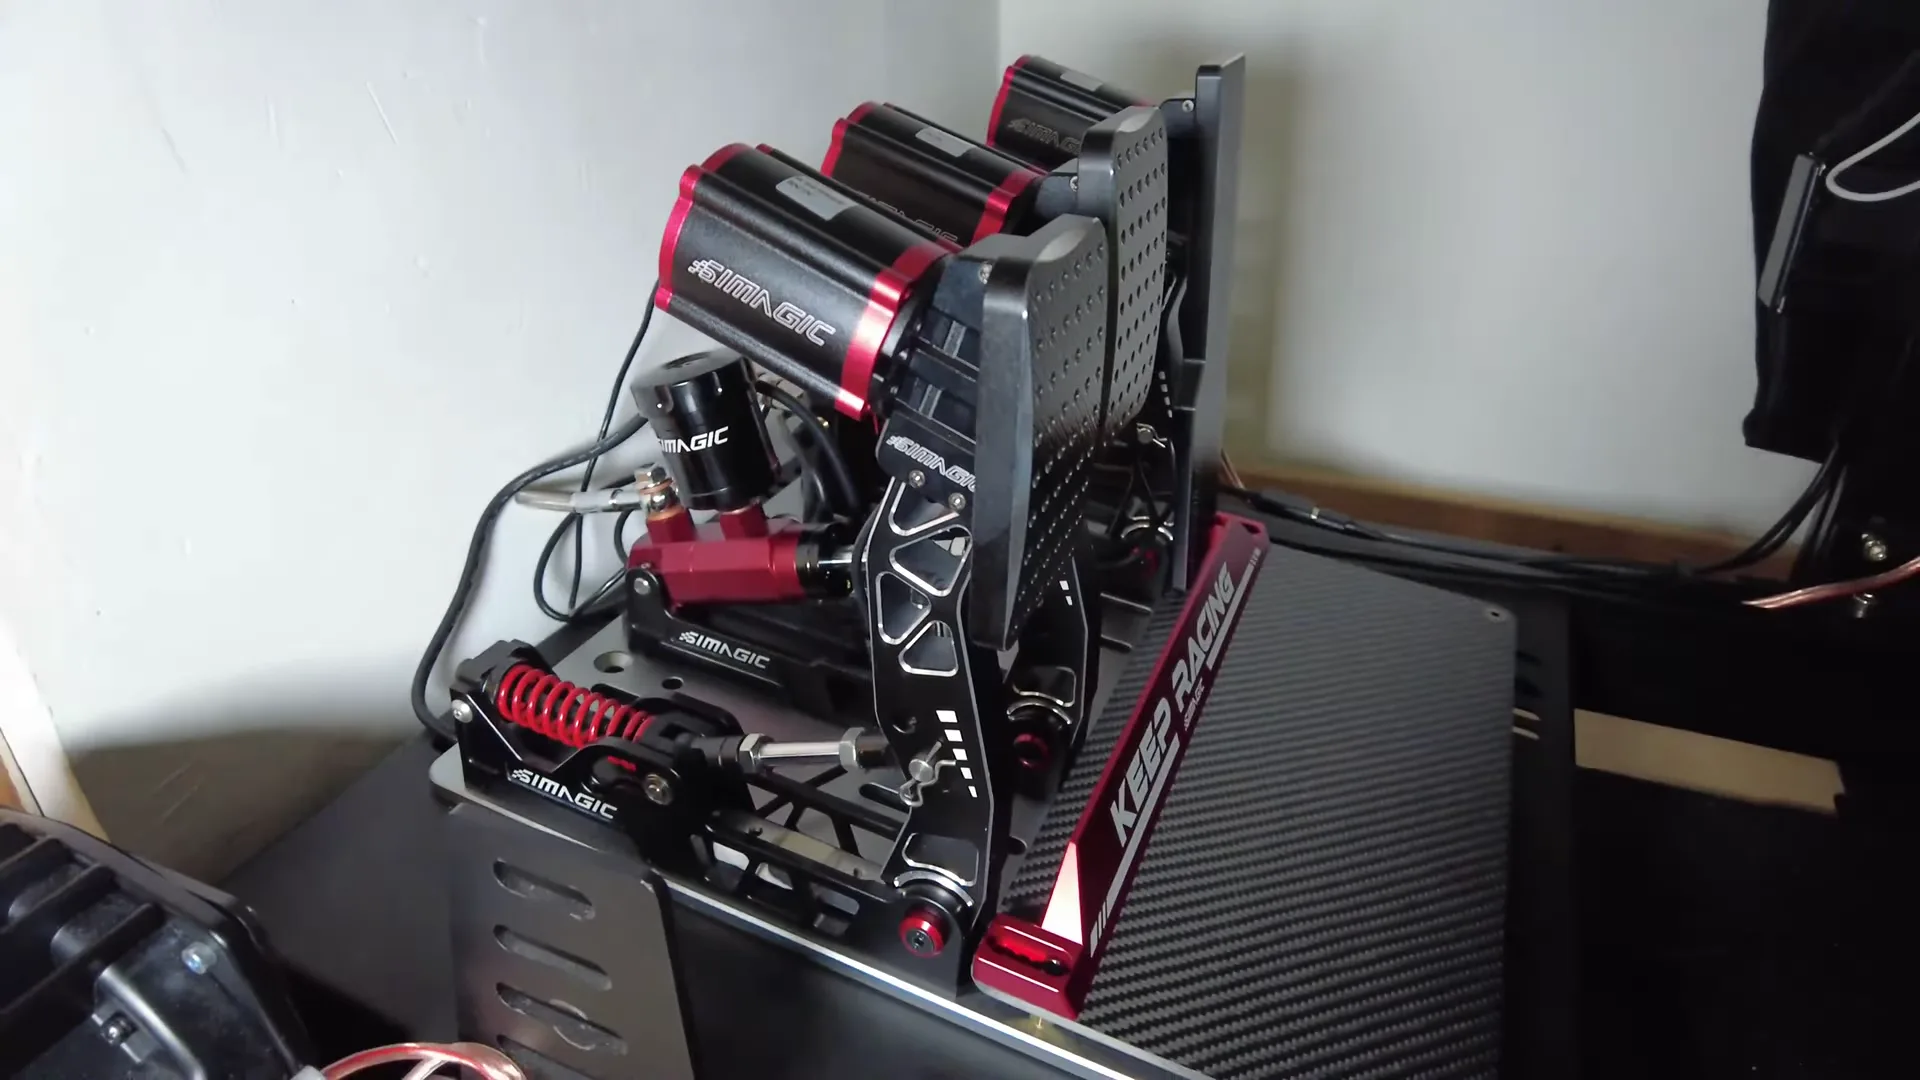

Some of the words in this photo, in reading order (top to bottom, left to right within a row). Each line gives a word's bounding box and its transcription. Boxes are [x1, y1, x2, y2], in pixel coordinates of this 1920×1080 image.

[1007, 118, 1081, 156] SIMAG
[688, 259, 836, 346] SIMAGIC
[658, 425, 729, 454] IMAGIC
[679, 631, 770, 669] SIMAGIC
[1110, 697, 1171, 848] KEEP
[1171, 561, 1235, 713] RACING
[511, 768, 618, 819] SIMAGIC
